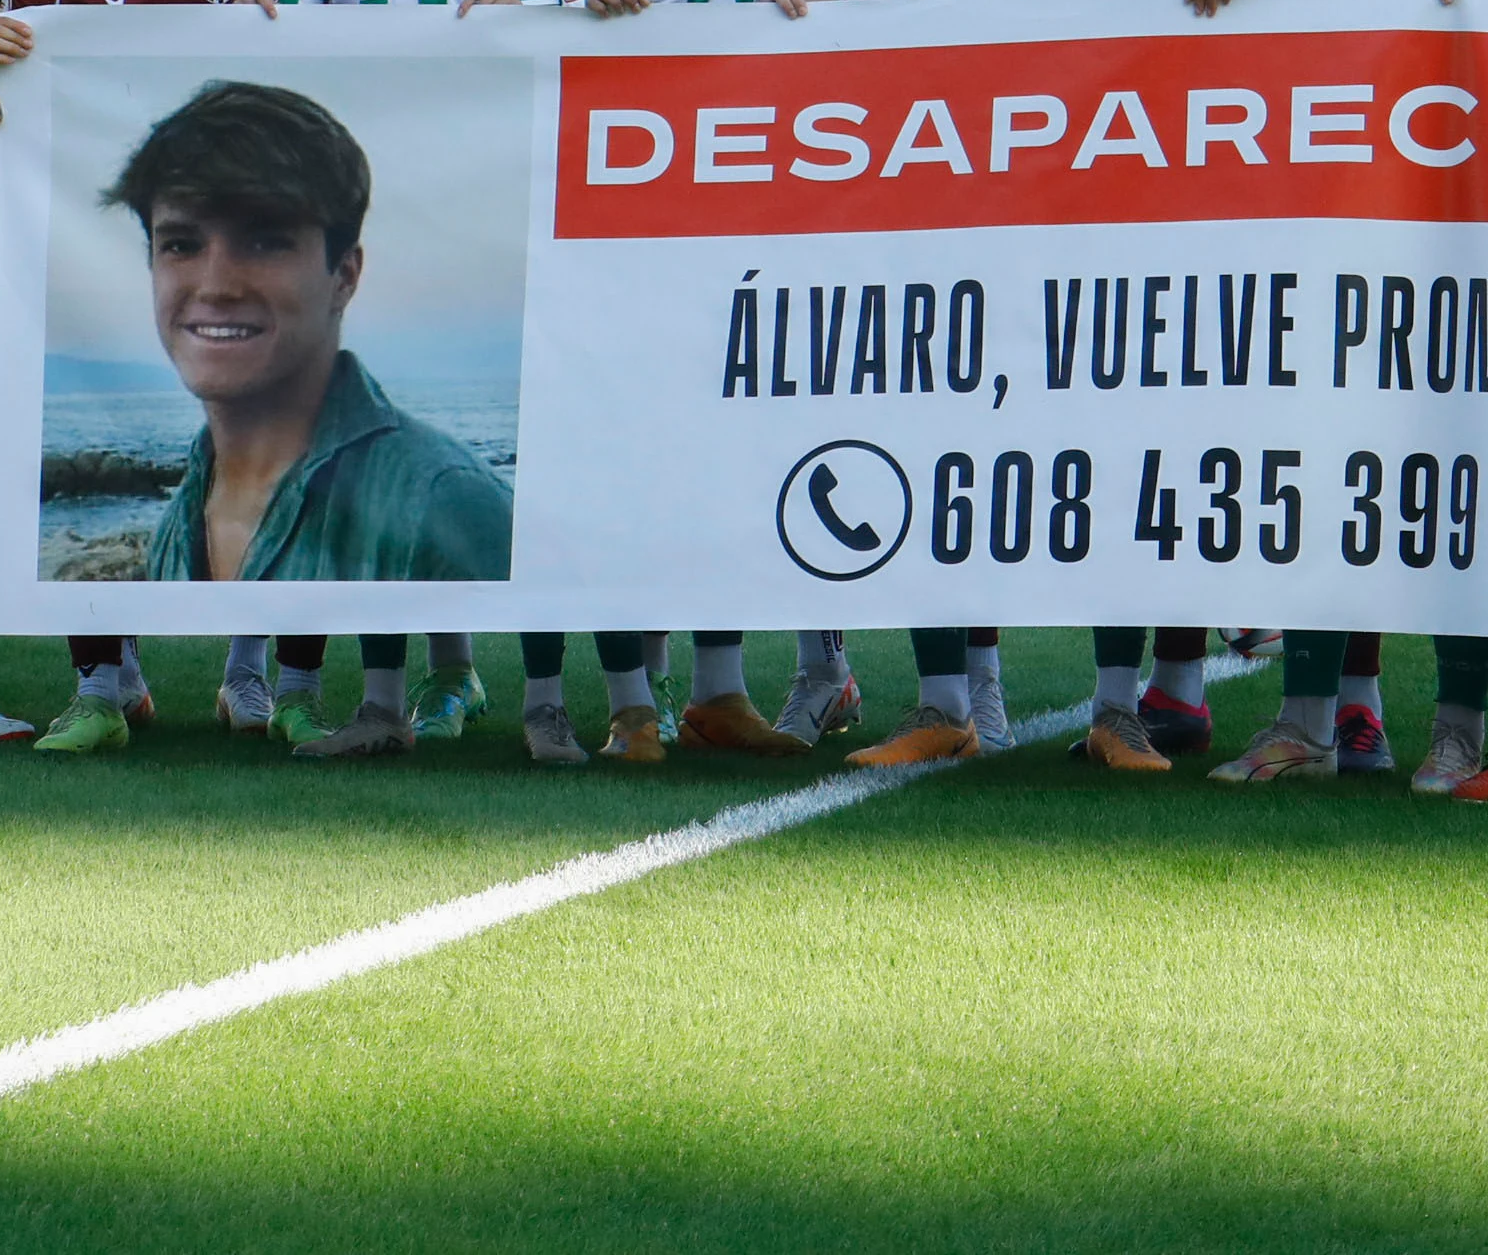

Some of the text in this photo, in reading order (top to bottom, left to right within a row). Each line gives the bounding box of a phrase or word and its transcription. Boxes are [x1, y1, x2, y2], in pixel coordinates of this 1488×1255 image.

[722, 270, 1010, 410] ÁLVARO,
[1044, 273, 1299, 391] VUELVE
[931, 447, 1480, 571] 608 435 399
